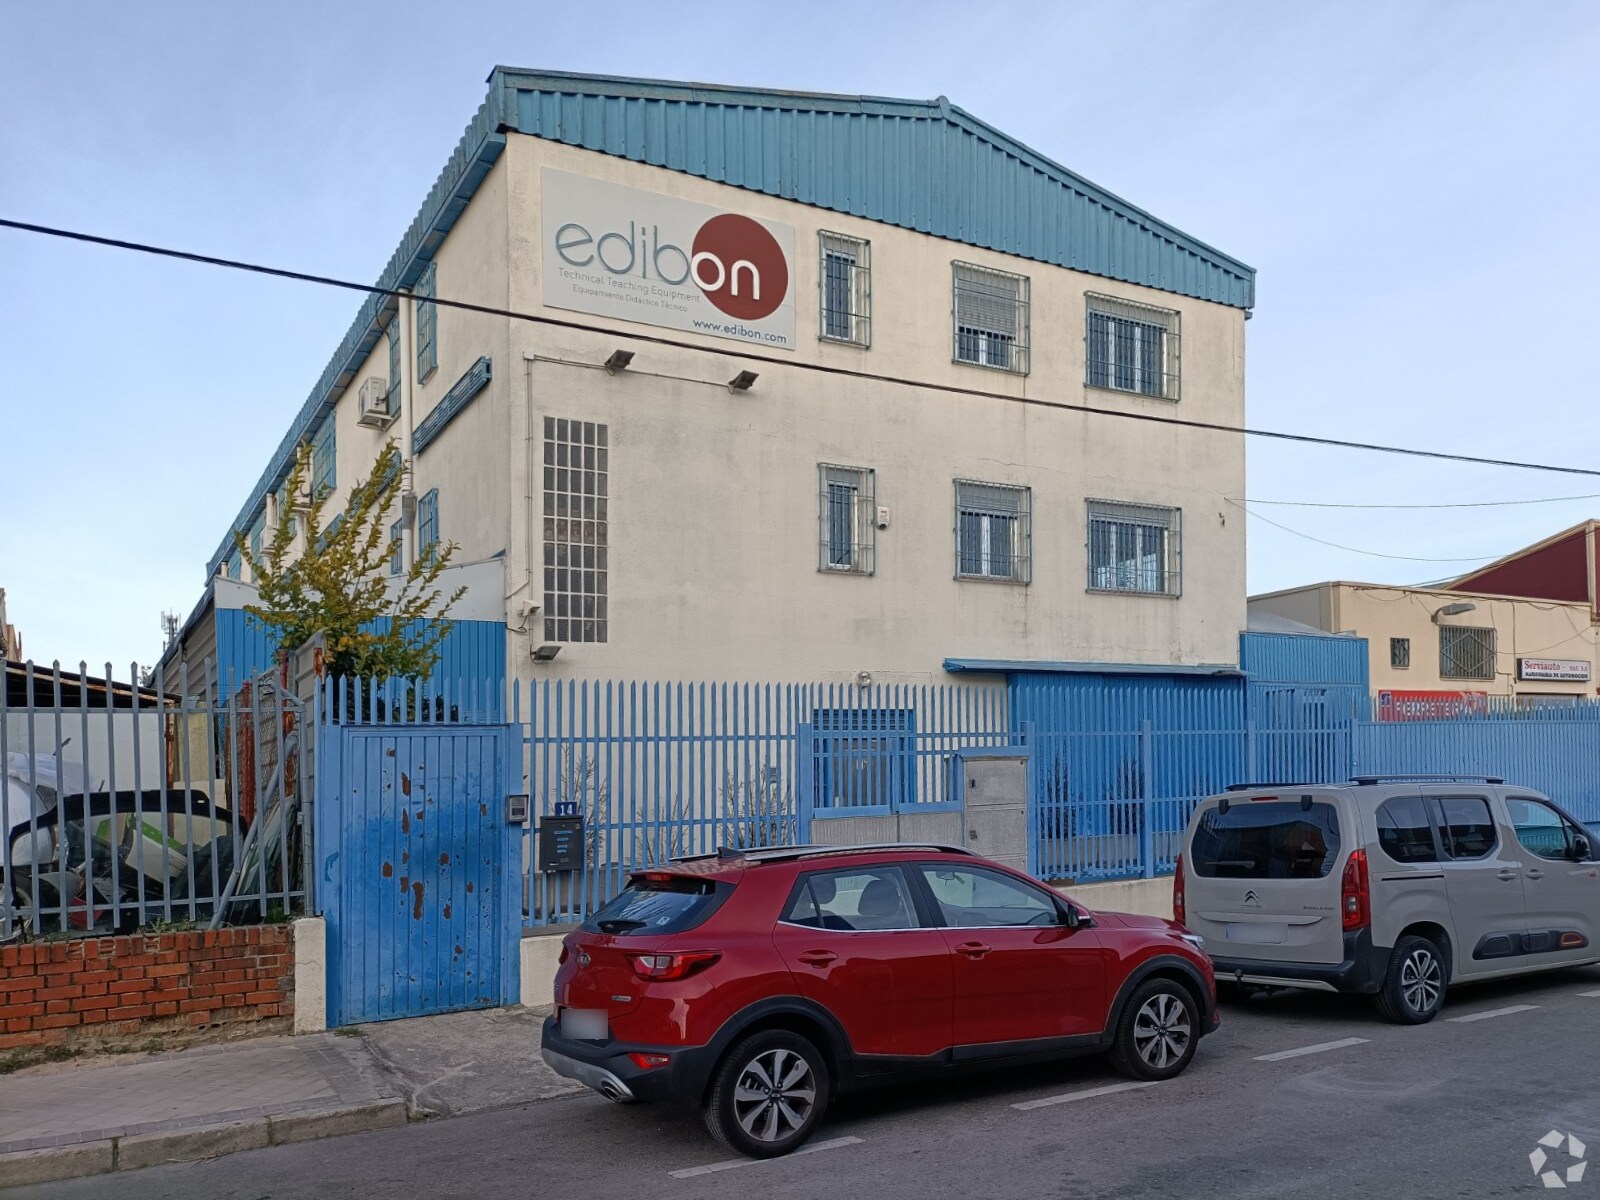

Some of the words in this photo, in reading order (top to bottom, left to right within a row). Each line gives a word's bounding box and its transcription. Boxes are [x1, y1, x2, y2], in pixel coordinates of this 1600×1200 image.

[556, 221, 760, 301] edibon
[559, 266, 605, 285] Technical
[608, 276, 648, 296] Teaching
[651, 285, 701, 303] Equipment
[573, 283, 624, 301] Equipamiento
[692, 319, 787, 344] www.edibon.com
[1524, 660, 1561, 671] Serviauto
[560, 804, 573, 816] 14
